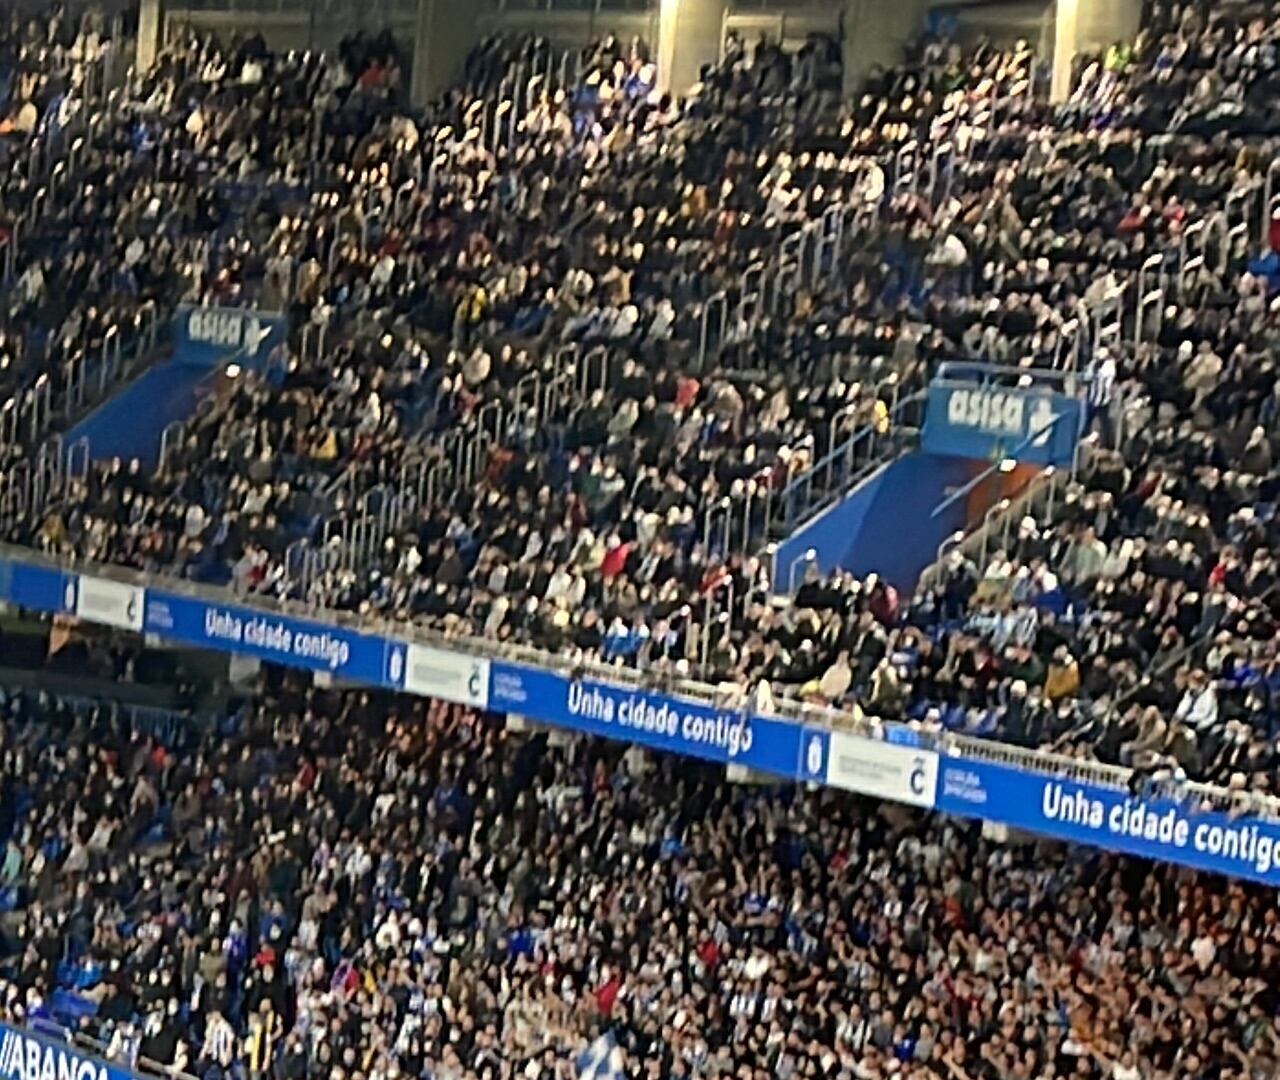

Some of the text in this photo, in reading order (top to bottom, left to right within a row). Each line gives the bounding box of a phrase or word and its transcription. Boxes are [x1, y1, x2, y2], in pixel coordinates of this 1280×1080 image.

[948, 389, 1024, 435] asisa
[205, 608, 240, 640] Unha
[243, 617, 292, 653] cidade
[294, 632, 349, 668] contigo
[568, 682, 614, 723] Unha
[618, 694, 679, 738] cidade
[682, 712, 753, 756] contigo
[1042, 782, 1104, 830] Unha
[1109, 798, 1189, 848] cidade
